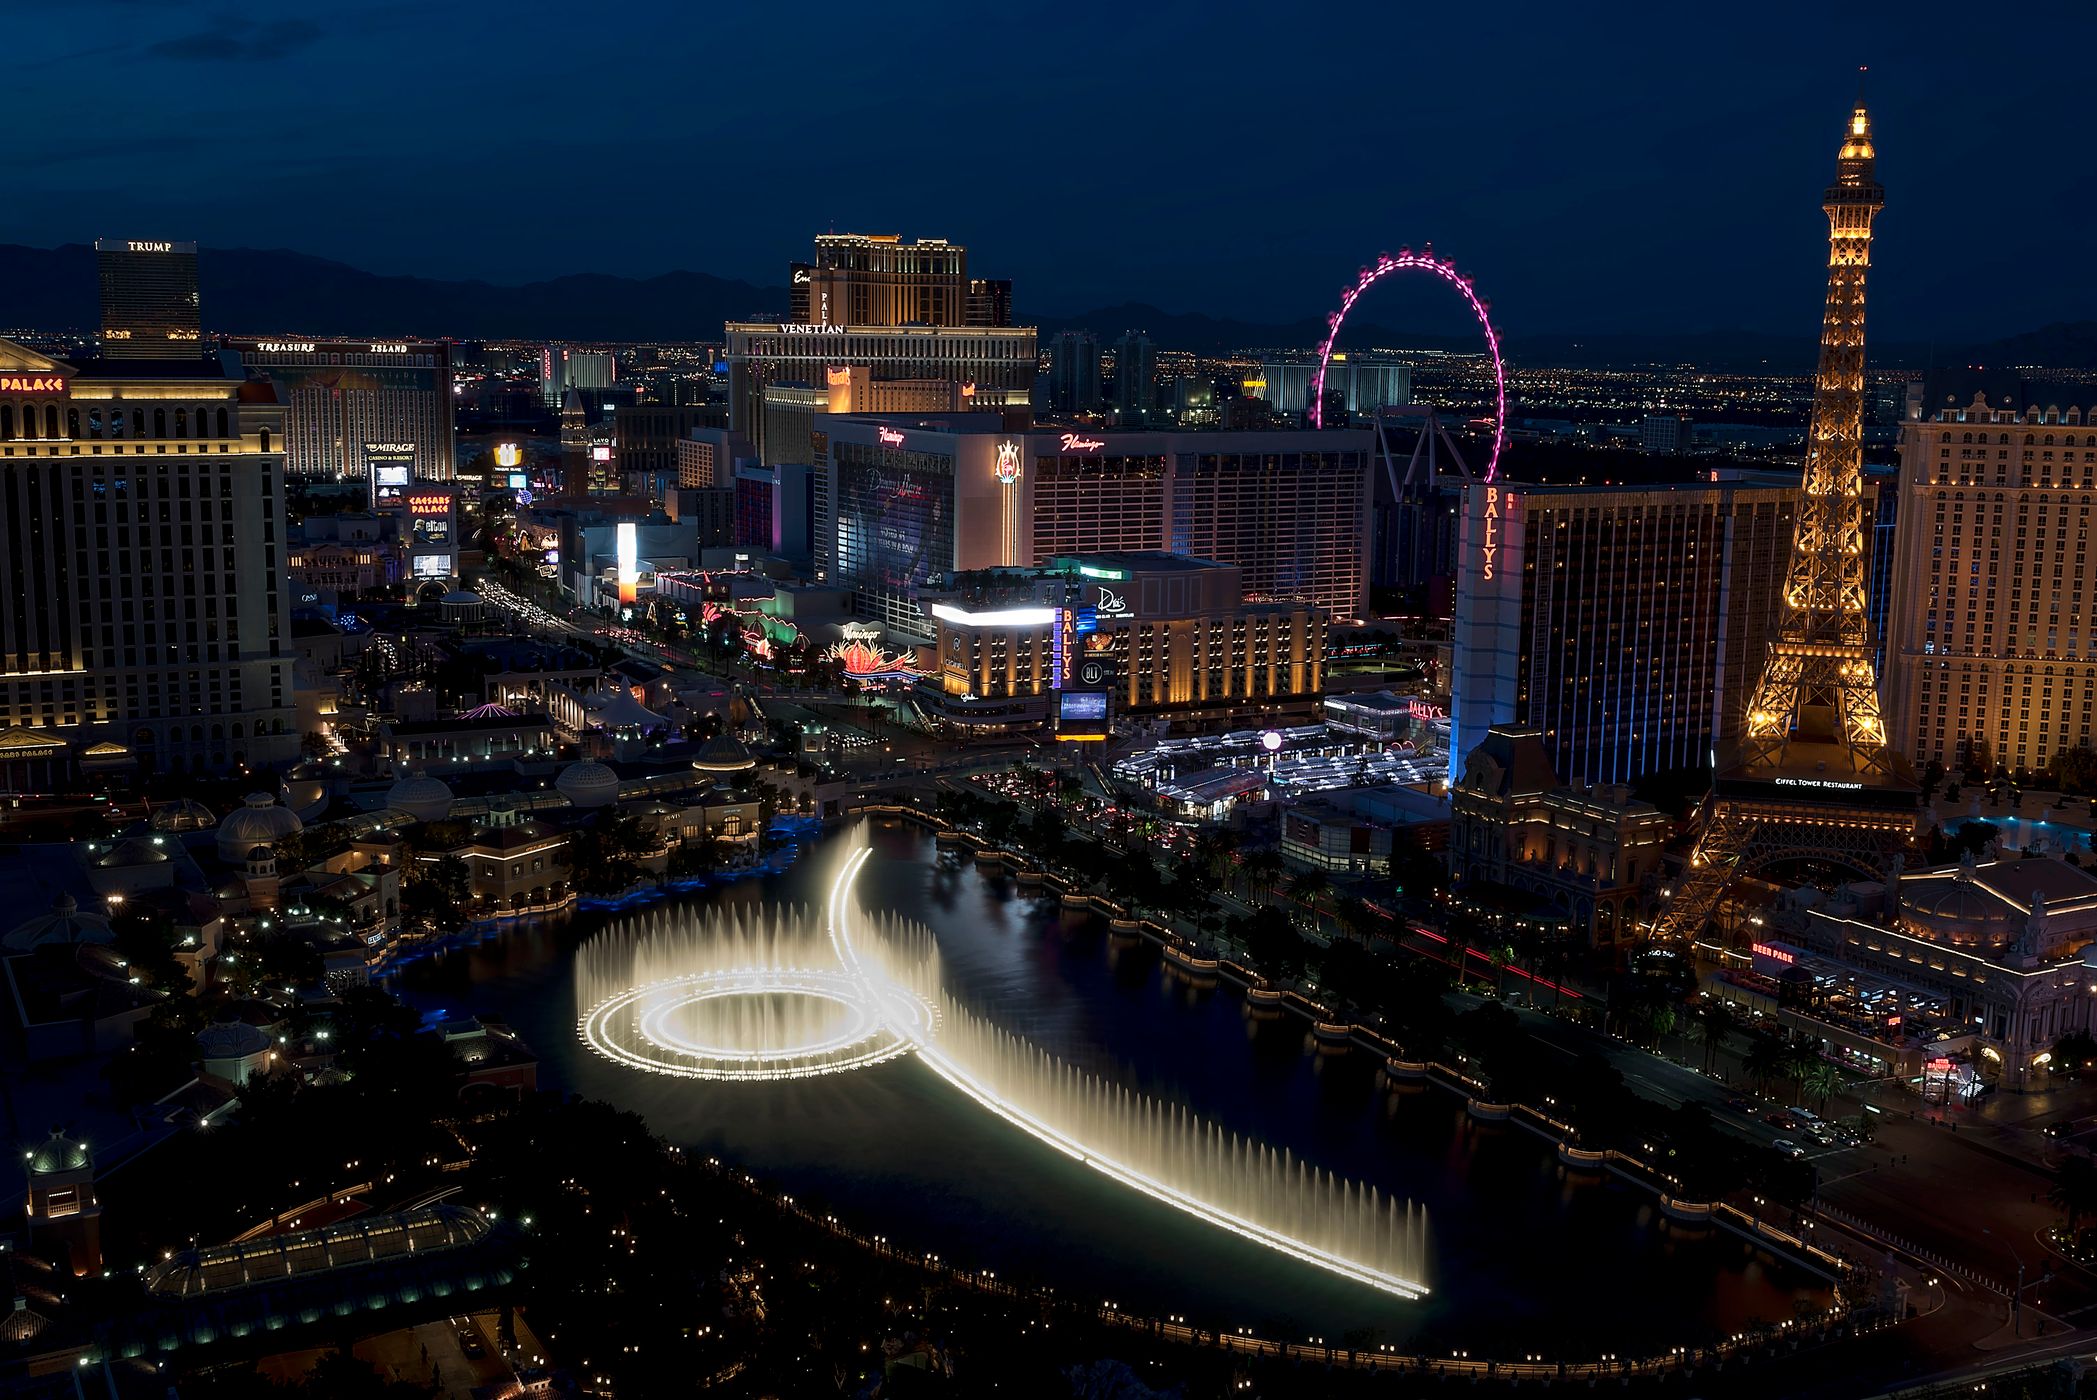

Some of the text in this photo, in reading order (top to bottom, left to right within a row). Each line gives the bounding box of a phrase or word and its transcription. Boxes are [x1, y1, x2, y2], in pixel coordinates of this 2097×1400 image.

[127, 241, 172, 252] TRUMP
[780, 323, 844, 334] VENETIAN
[257, 343, 408, 354] TREASURE ISLAND
[1, 378, 63, 391] PALACE
[879, 426, 905, 447] Flamingo
[1060, 433, 1105, 452] Flamingo
[377, 443, 415, 452] MIRAGE
[409, 496, 450, 505] CAESARS
[411, 505, 449, 514] PALACE
[425, 520, 447, 532] elton
[1483, 487, 1499, 580] BALLYS
[1097, 586, 1126, 612] Drai's
[843, 625, 880, 641] Flamingo
[1062, 610, 1073, 680] BALLYS
[1086, 666, 1098, 679] BLT
[1775, 778, 1863, 790] EIFFEL TOWER RESTAURANT
[1752, 943, 1793, 963] BEER PARK
